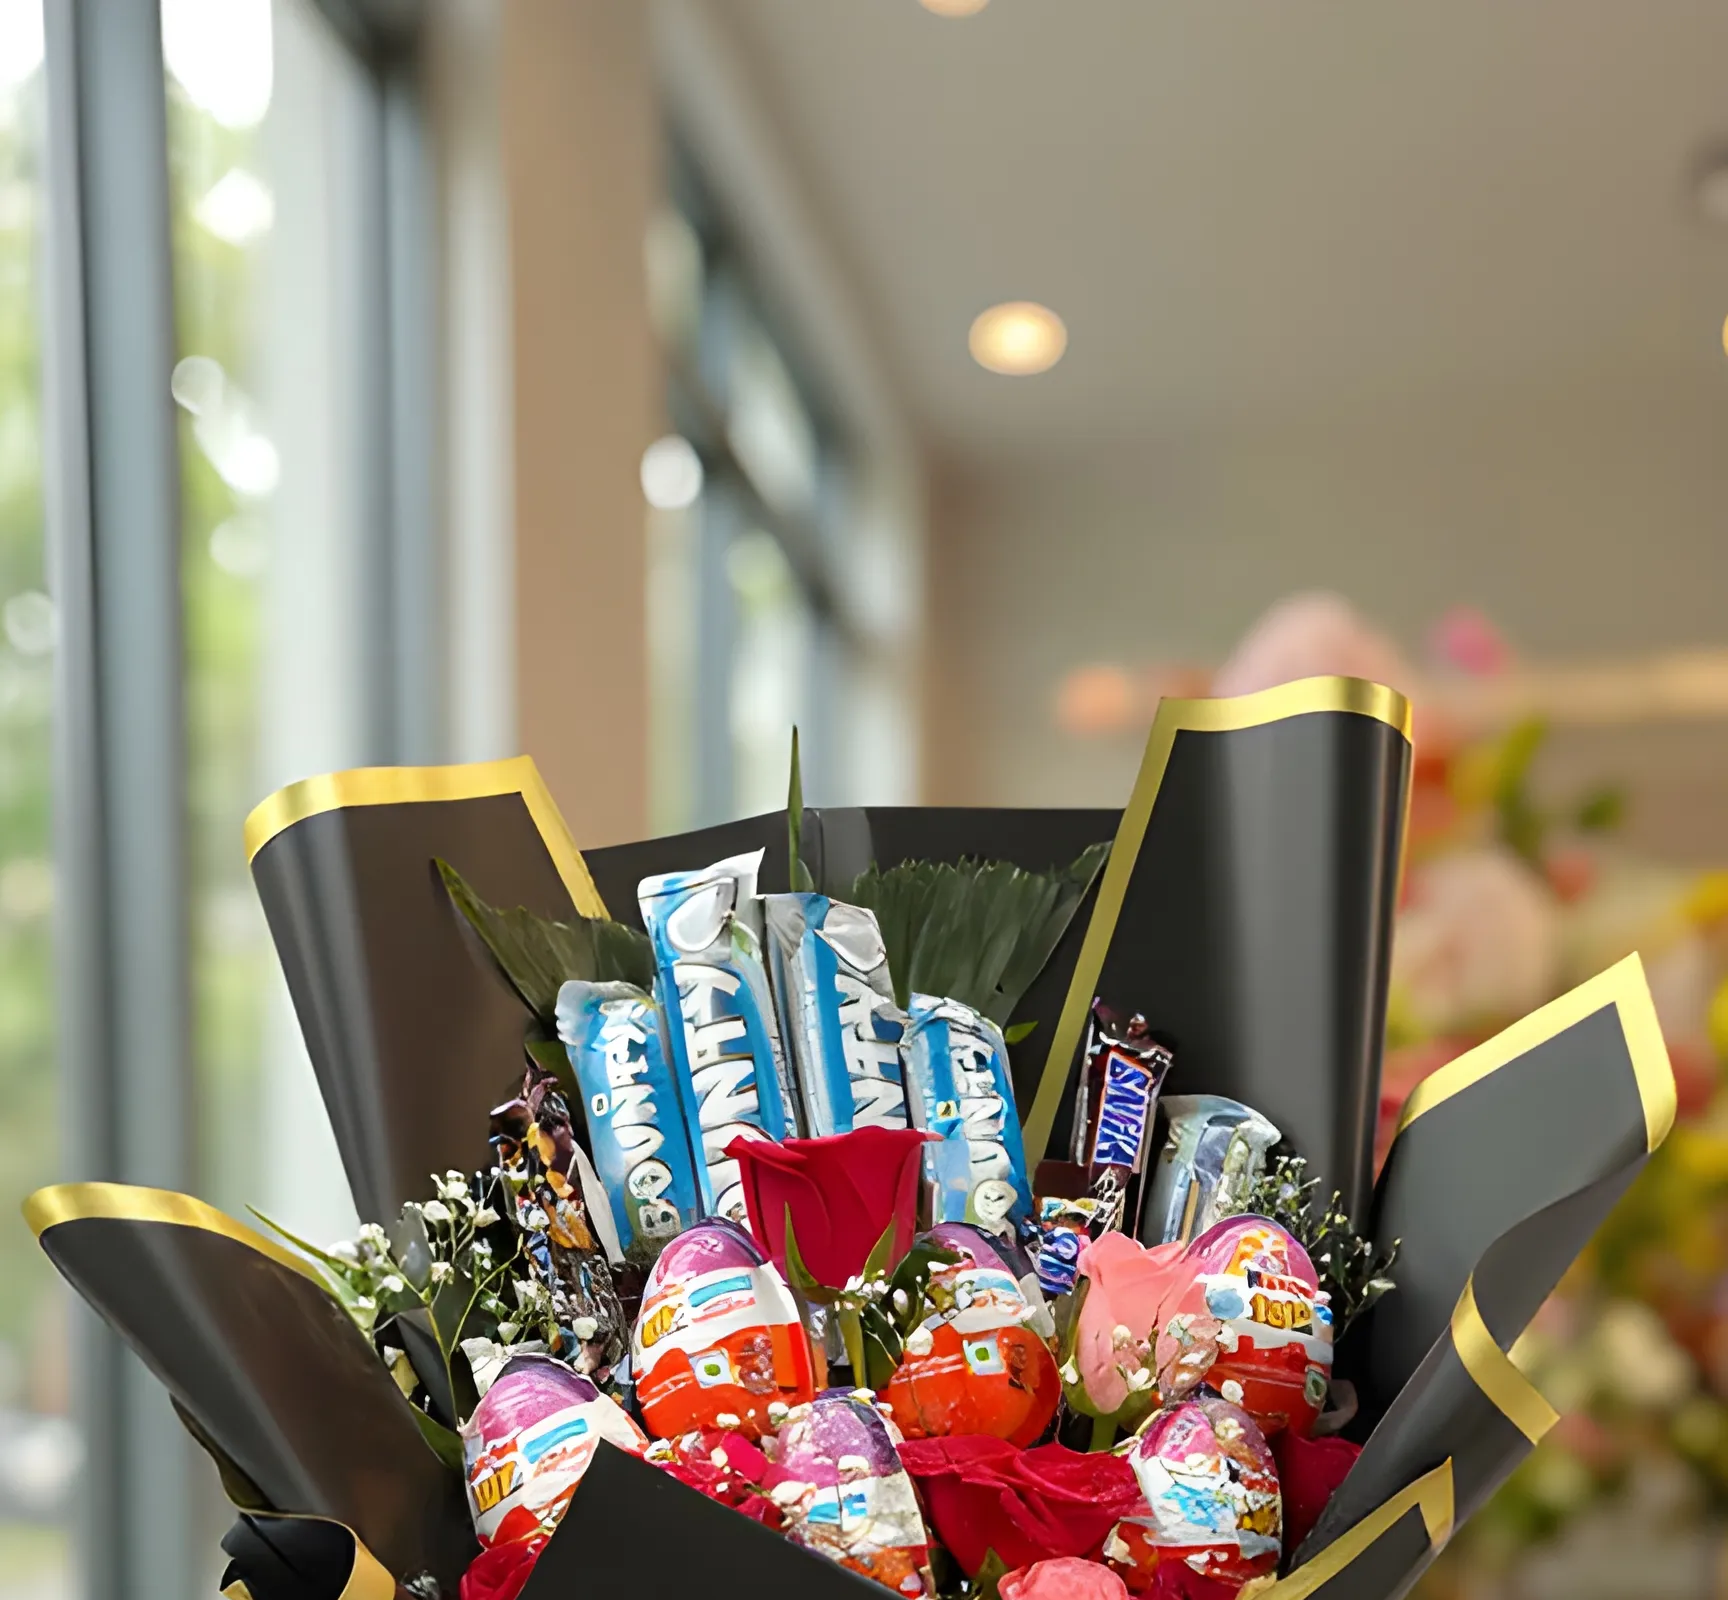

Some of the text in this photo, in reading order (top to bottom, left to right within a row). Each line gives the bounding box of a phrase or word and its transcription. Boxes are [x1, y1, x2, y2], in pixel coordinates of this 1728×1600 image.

[602, 1024, 682, 1238] BOUNTY
[673, 961, 766, 1230] UNTY
[836, 974, 908, 1130] NTY
